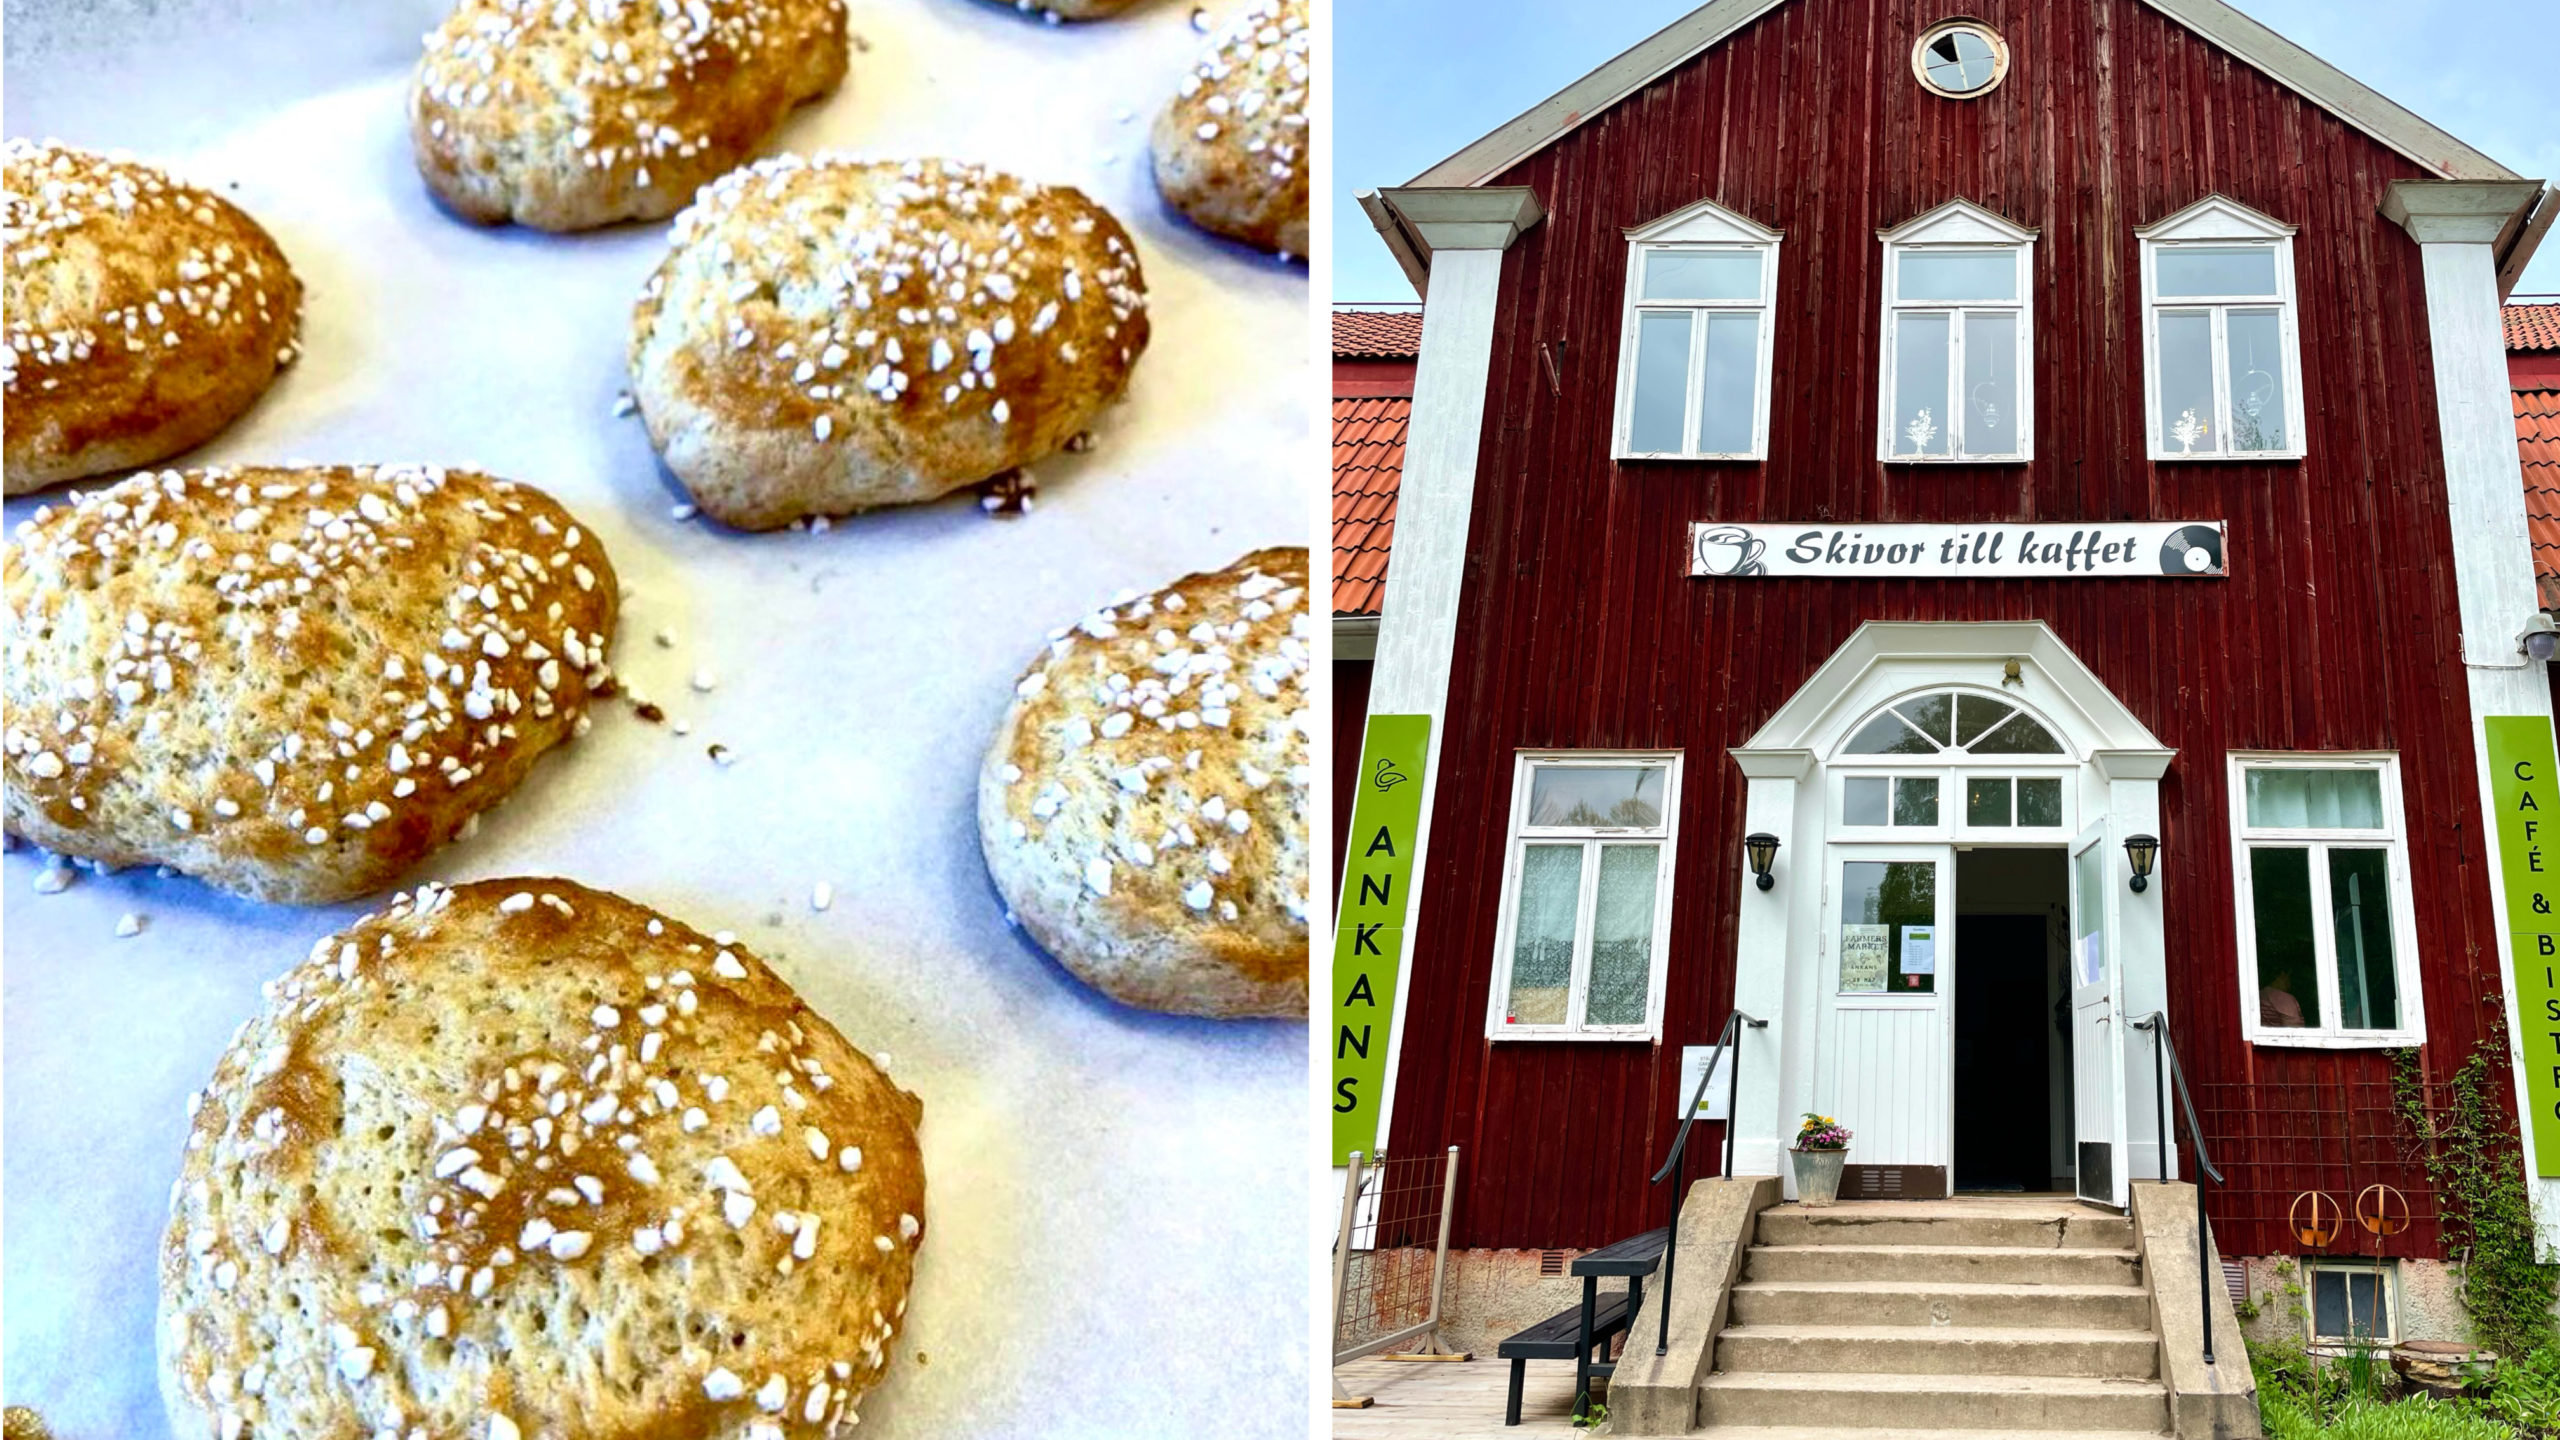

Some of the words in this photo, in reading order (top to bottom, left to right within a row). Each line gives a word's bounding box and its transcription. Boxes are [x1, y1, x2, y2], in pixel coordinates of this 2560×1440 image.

[1786, 531, 1924, 565] Skivor
[1941, 530, 2003, 564] till
[2018, 530, 2137, 571] kaffet
[2513, 761, 2545, 873] CAFÉ
[2531, 892, 2552, 915] &
[1332, 825, 1396, 1114] ANKANS
[2537, 934, 2560, 1121] BIST
